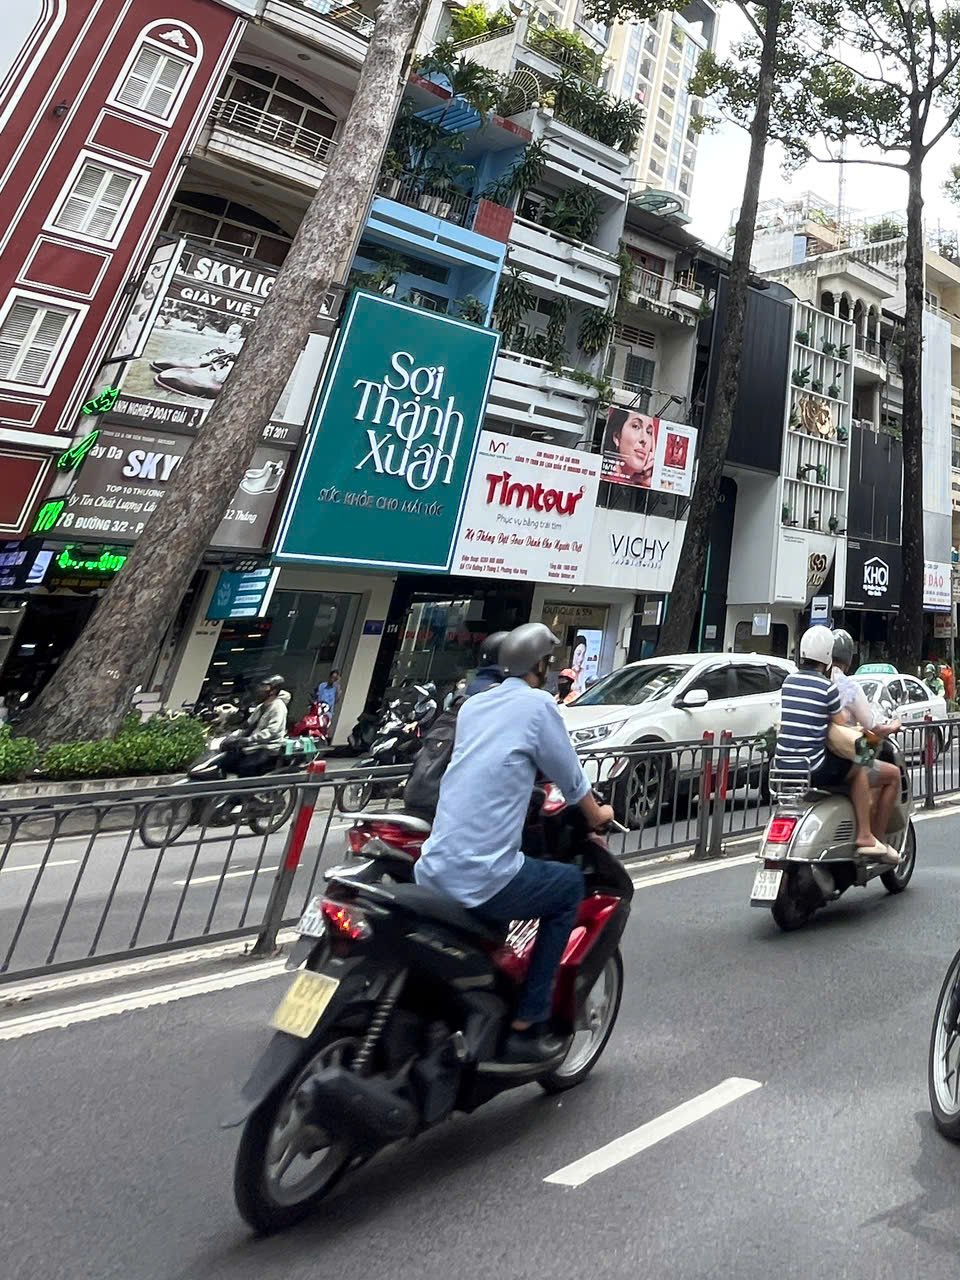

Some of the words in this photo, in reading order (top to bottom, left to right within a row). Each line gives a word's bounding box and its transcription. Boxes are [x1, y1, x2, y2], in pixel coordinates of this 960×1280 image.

[180, 287, 223, 307] GIÀY
[384, 351, 445, 400] Sợi
[353, 379, 465, 447] Thanh
[107, 445, 123, 460] Da
[122, 450, 183, 481] SKY
[354, 428, 455, 491] Xuân
[106, 484, 121, 494] TOP
[121, 486, 132, 495] 10
[318, 486, 342, 504] SỨC
[376, 496, 398, 511] CHO
[75, 515, 109, 531] ĐƯỜNG
[111, 519, 127, 532] 3/2
[234, 509, 258, 523] Tháng
[611, 533, 670, 561] VICHY
